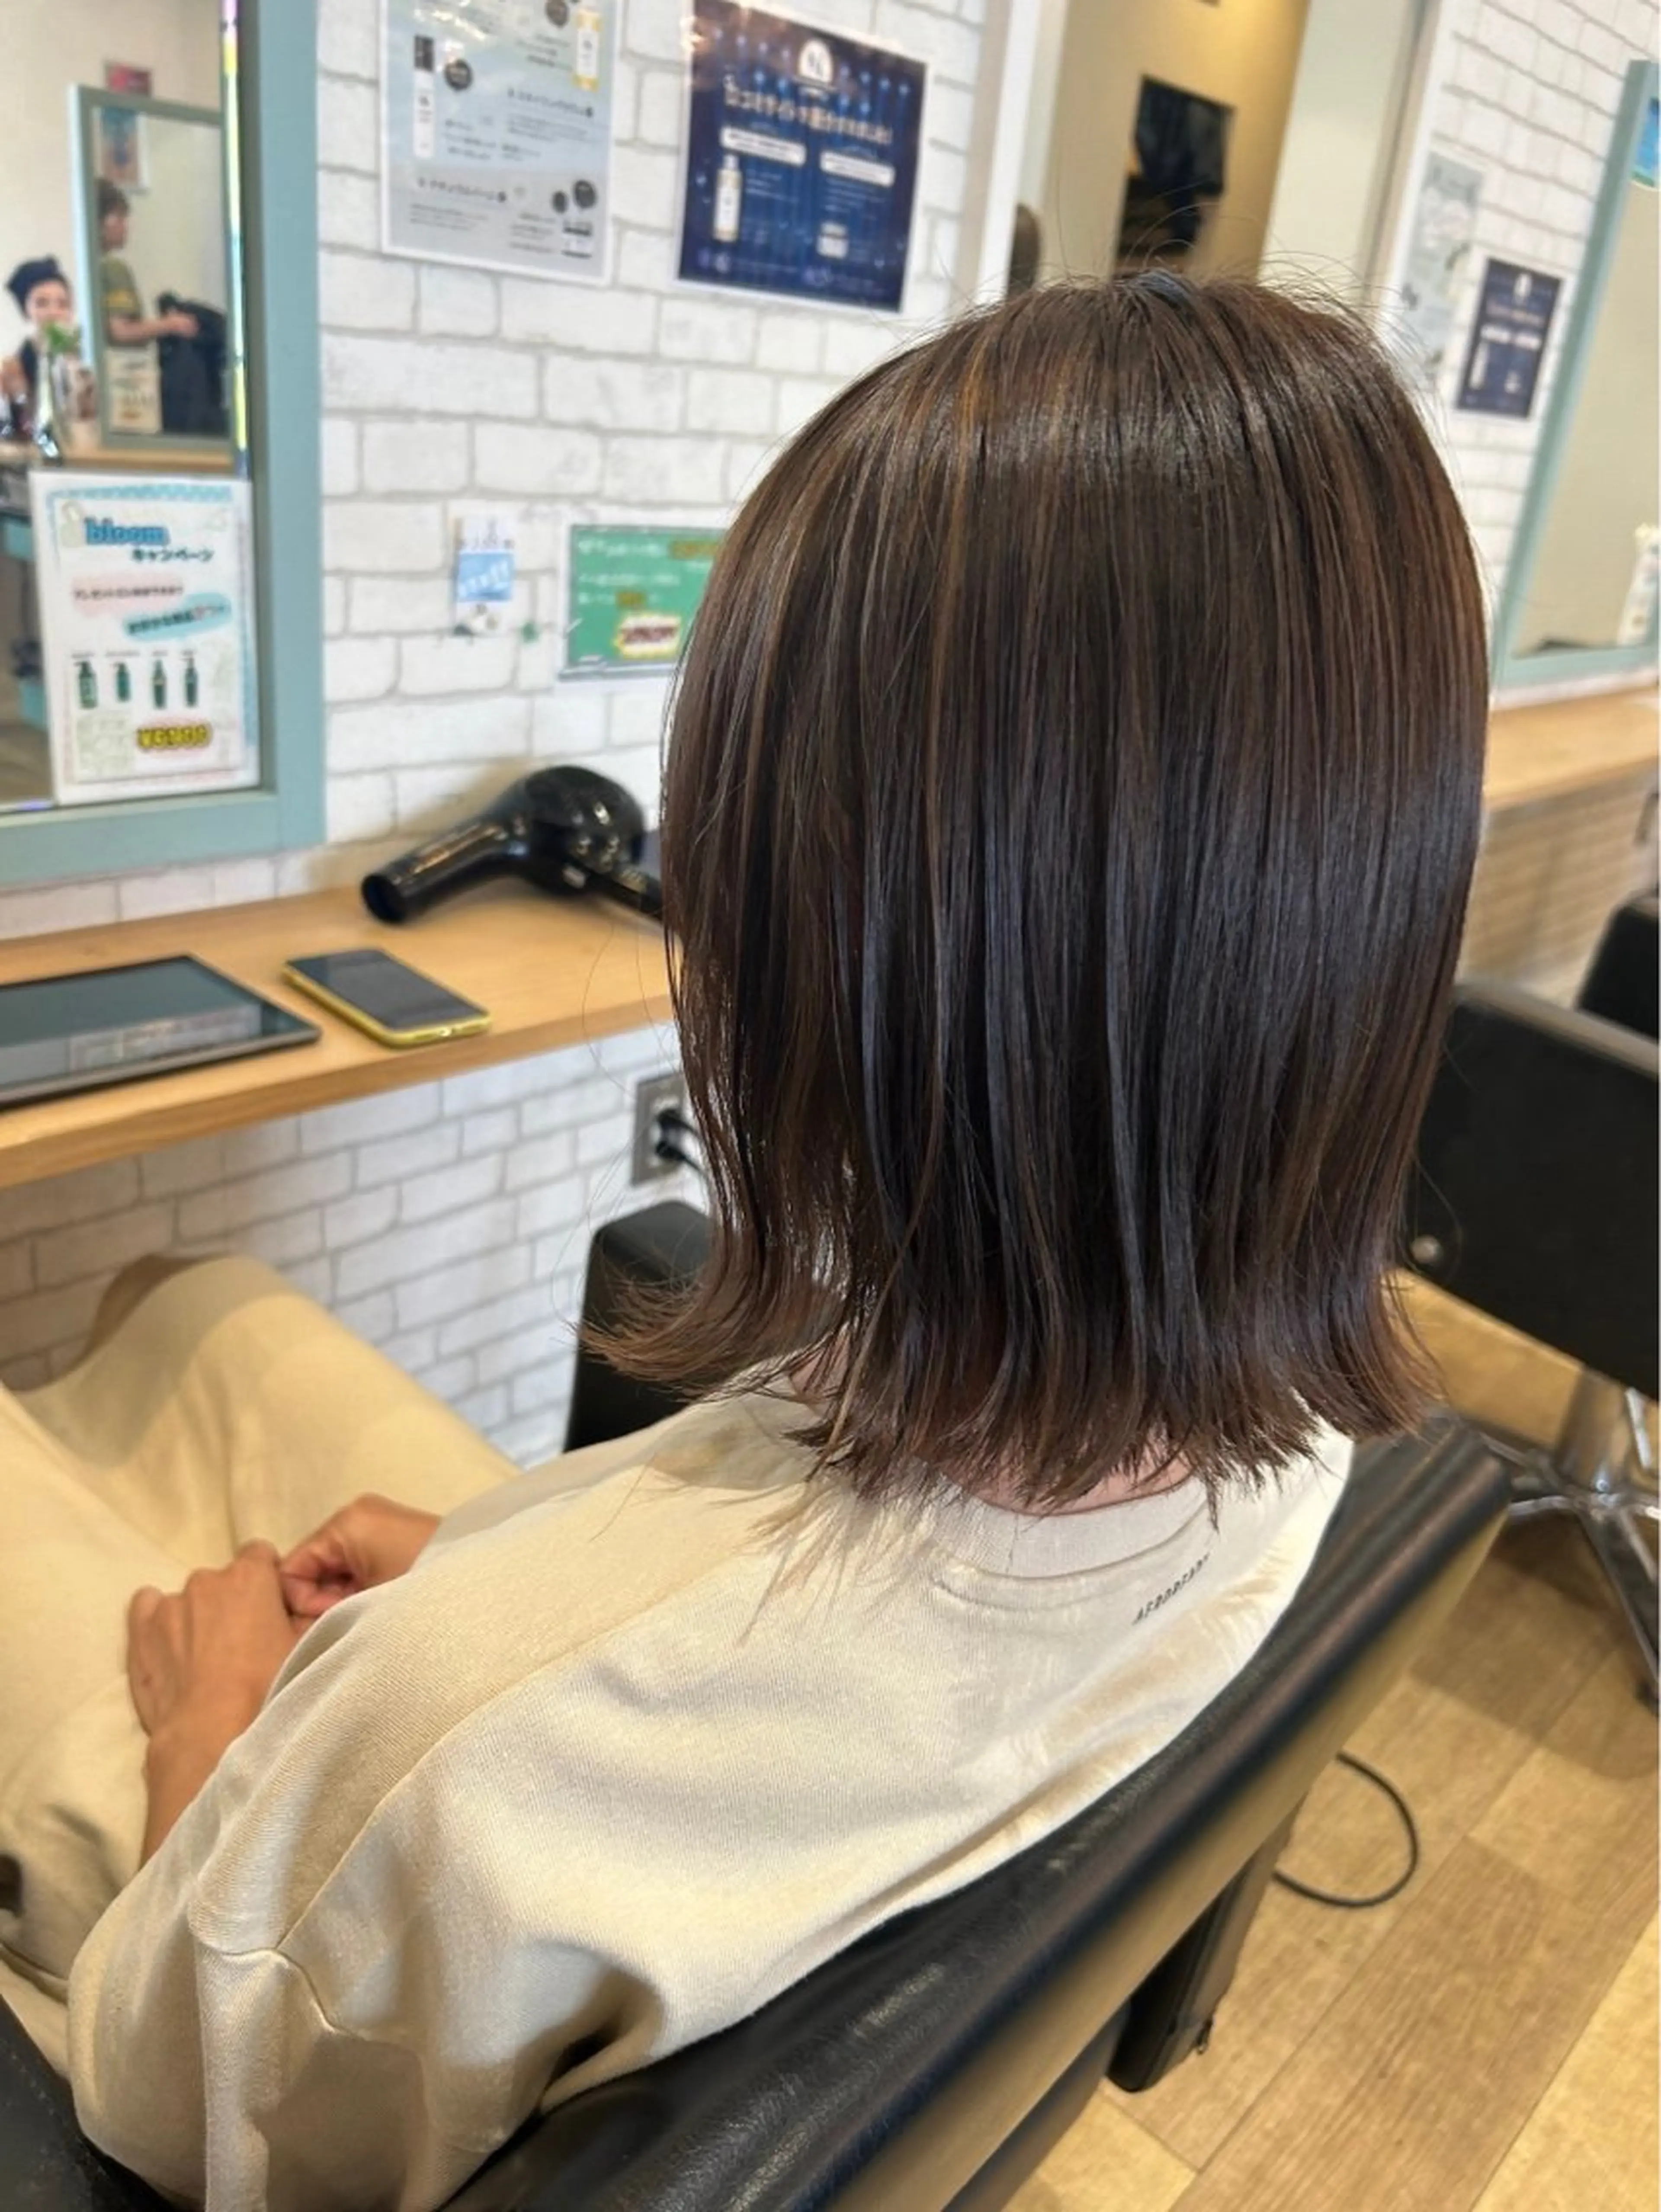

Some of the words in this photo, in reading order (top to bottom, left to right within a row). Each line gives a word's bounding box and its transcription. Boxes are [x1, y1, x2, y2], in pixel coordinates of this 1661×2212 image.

[85, 518, 168, 545] bloom
[131, 547, 214, 562] キャンペーン
